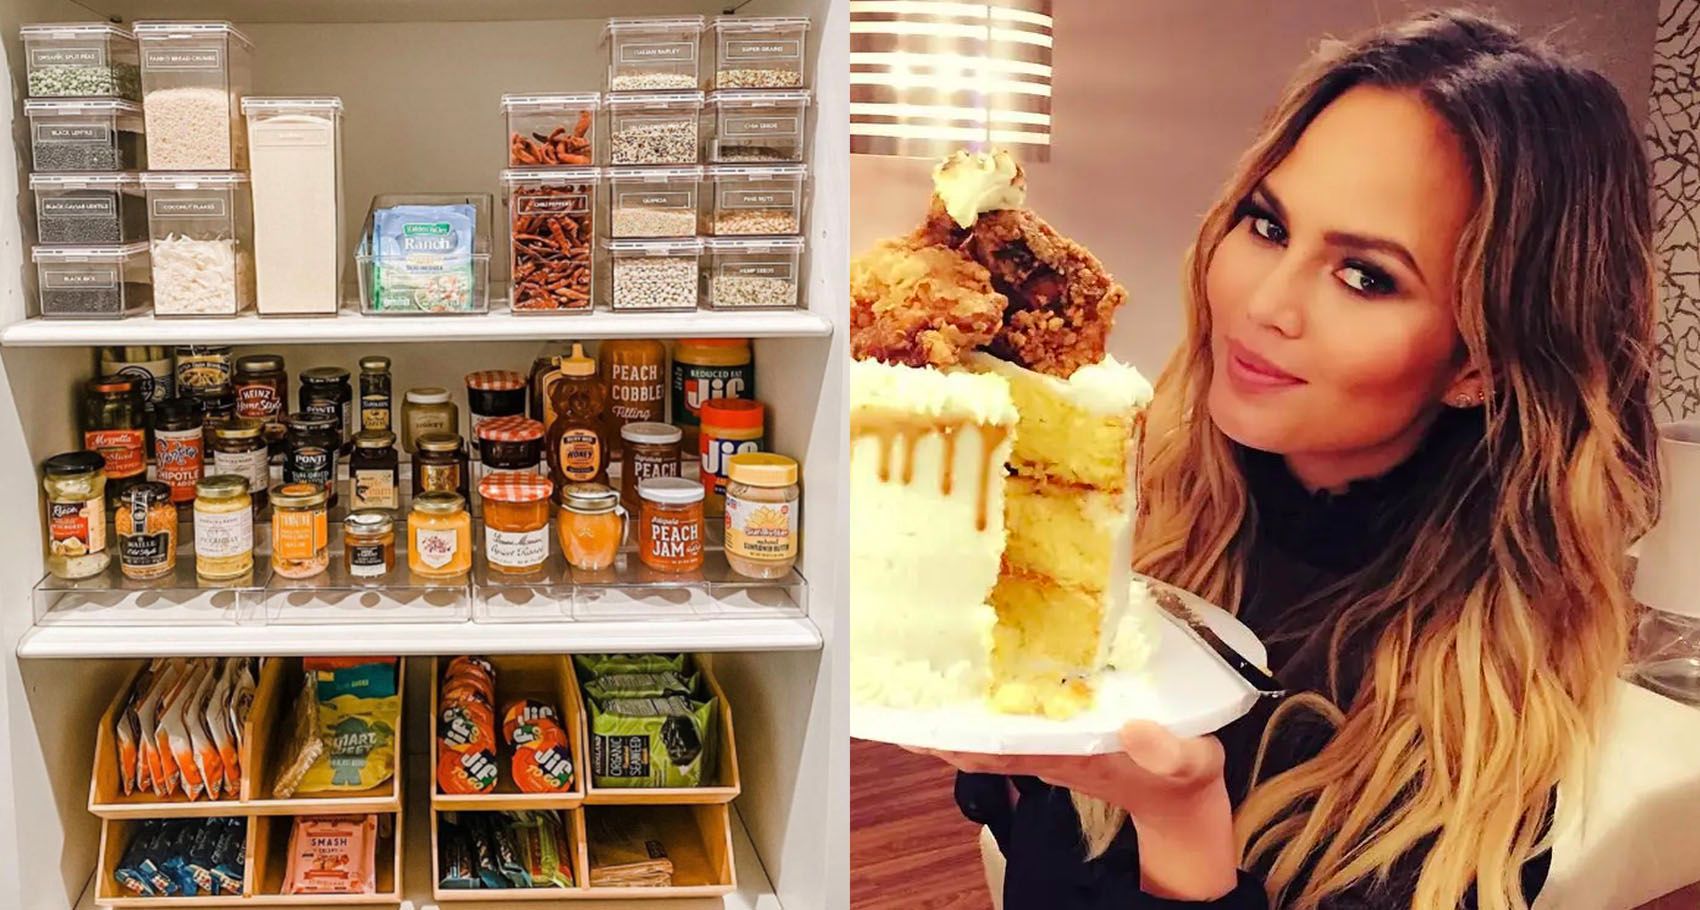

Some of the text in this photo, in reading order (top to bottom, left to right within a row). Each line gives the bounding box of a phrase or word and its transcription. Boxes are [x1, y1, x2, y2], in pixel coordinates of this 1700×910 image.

[404, 238, 450, 250] Ranch
[612, 364, 658, 380] PEACH
[690, 369, 743, 379] REDUCED FAT
[242, 389, 271, 399] HEINZ
[306, 406, 336, 414] PONTI
[612, 405, 651, 420] Filling
[295, 454, 327, 464] PONTI
[634, 461, 677, 478] PEACH
[651, 523, 698, 541] PEACH
[652, 540, 685, 557] JAM
[334, 732, 378, 751] MART
[534, 747, 573, 779] Jif
[610, 737, 622, 776] ORGANIC
[629, 736, 642, 776] SEAWEED
[460, 751, 498, 781] Jif
[311, 838, 348, 847] SMASH
